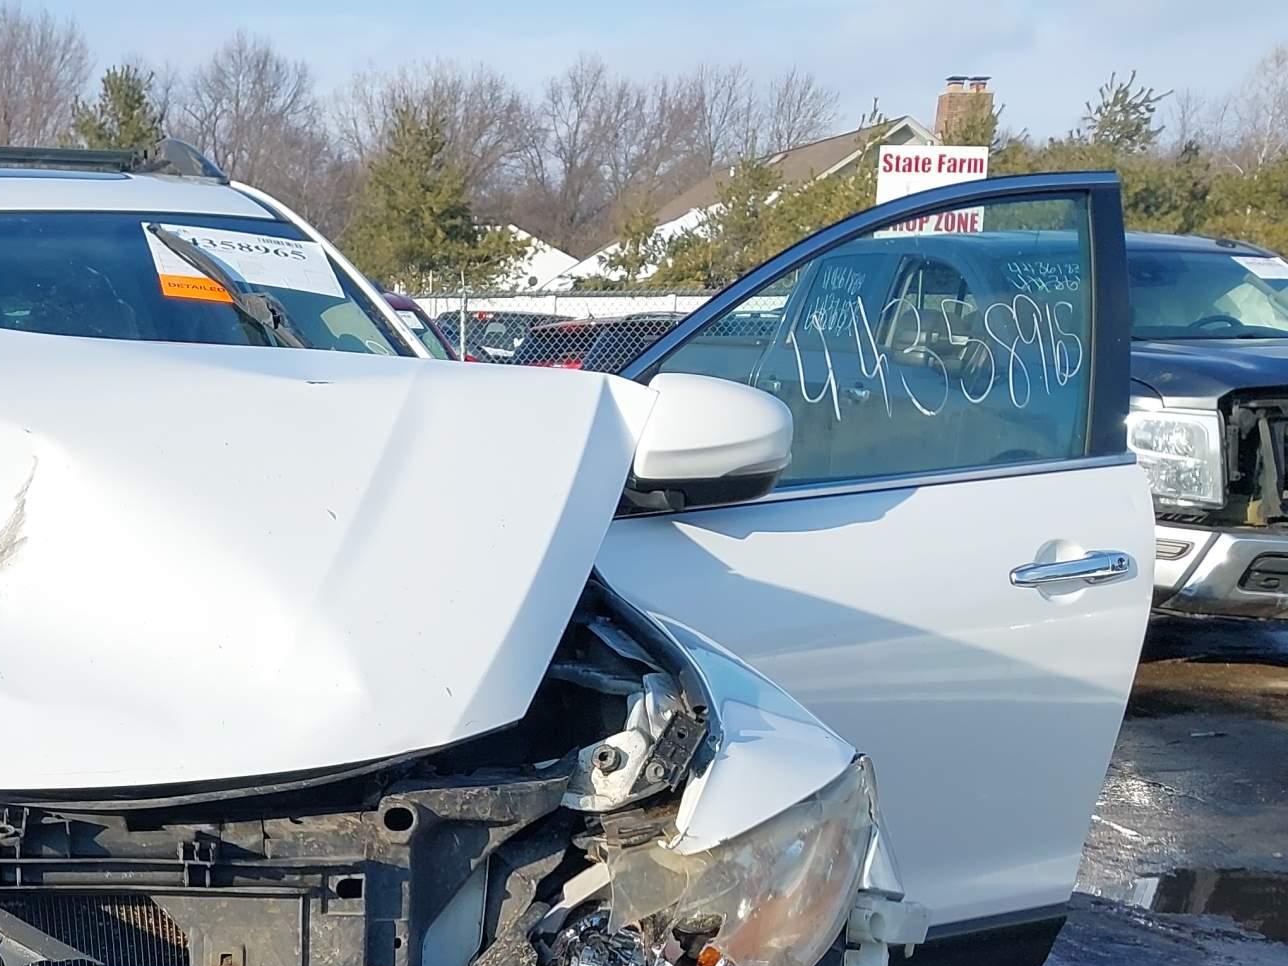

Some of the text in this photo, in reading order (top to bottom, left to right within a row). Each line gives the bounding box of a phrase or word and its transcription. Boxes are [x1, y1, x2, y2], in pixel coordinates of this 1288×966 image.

[882, 153, 985, 174] State Farm
[933, 211, 979, 233] ZONE
